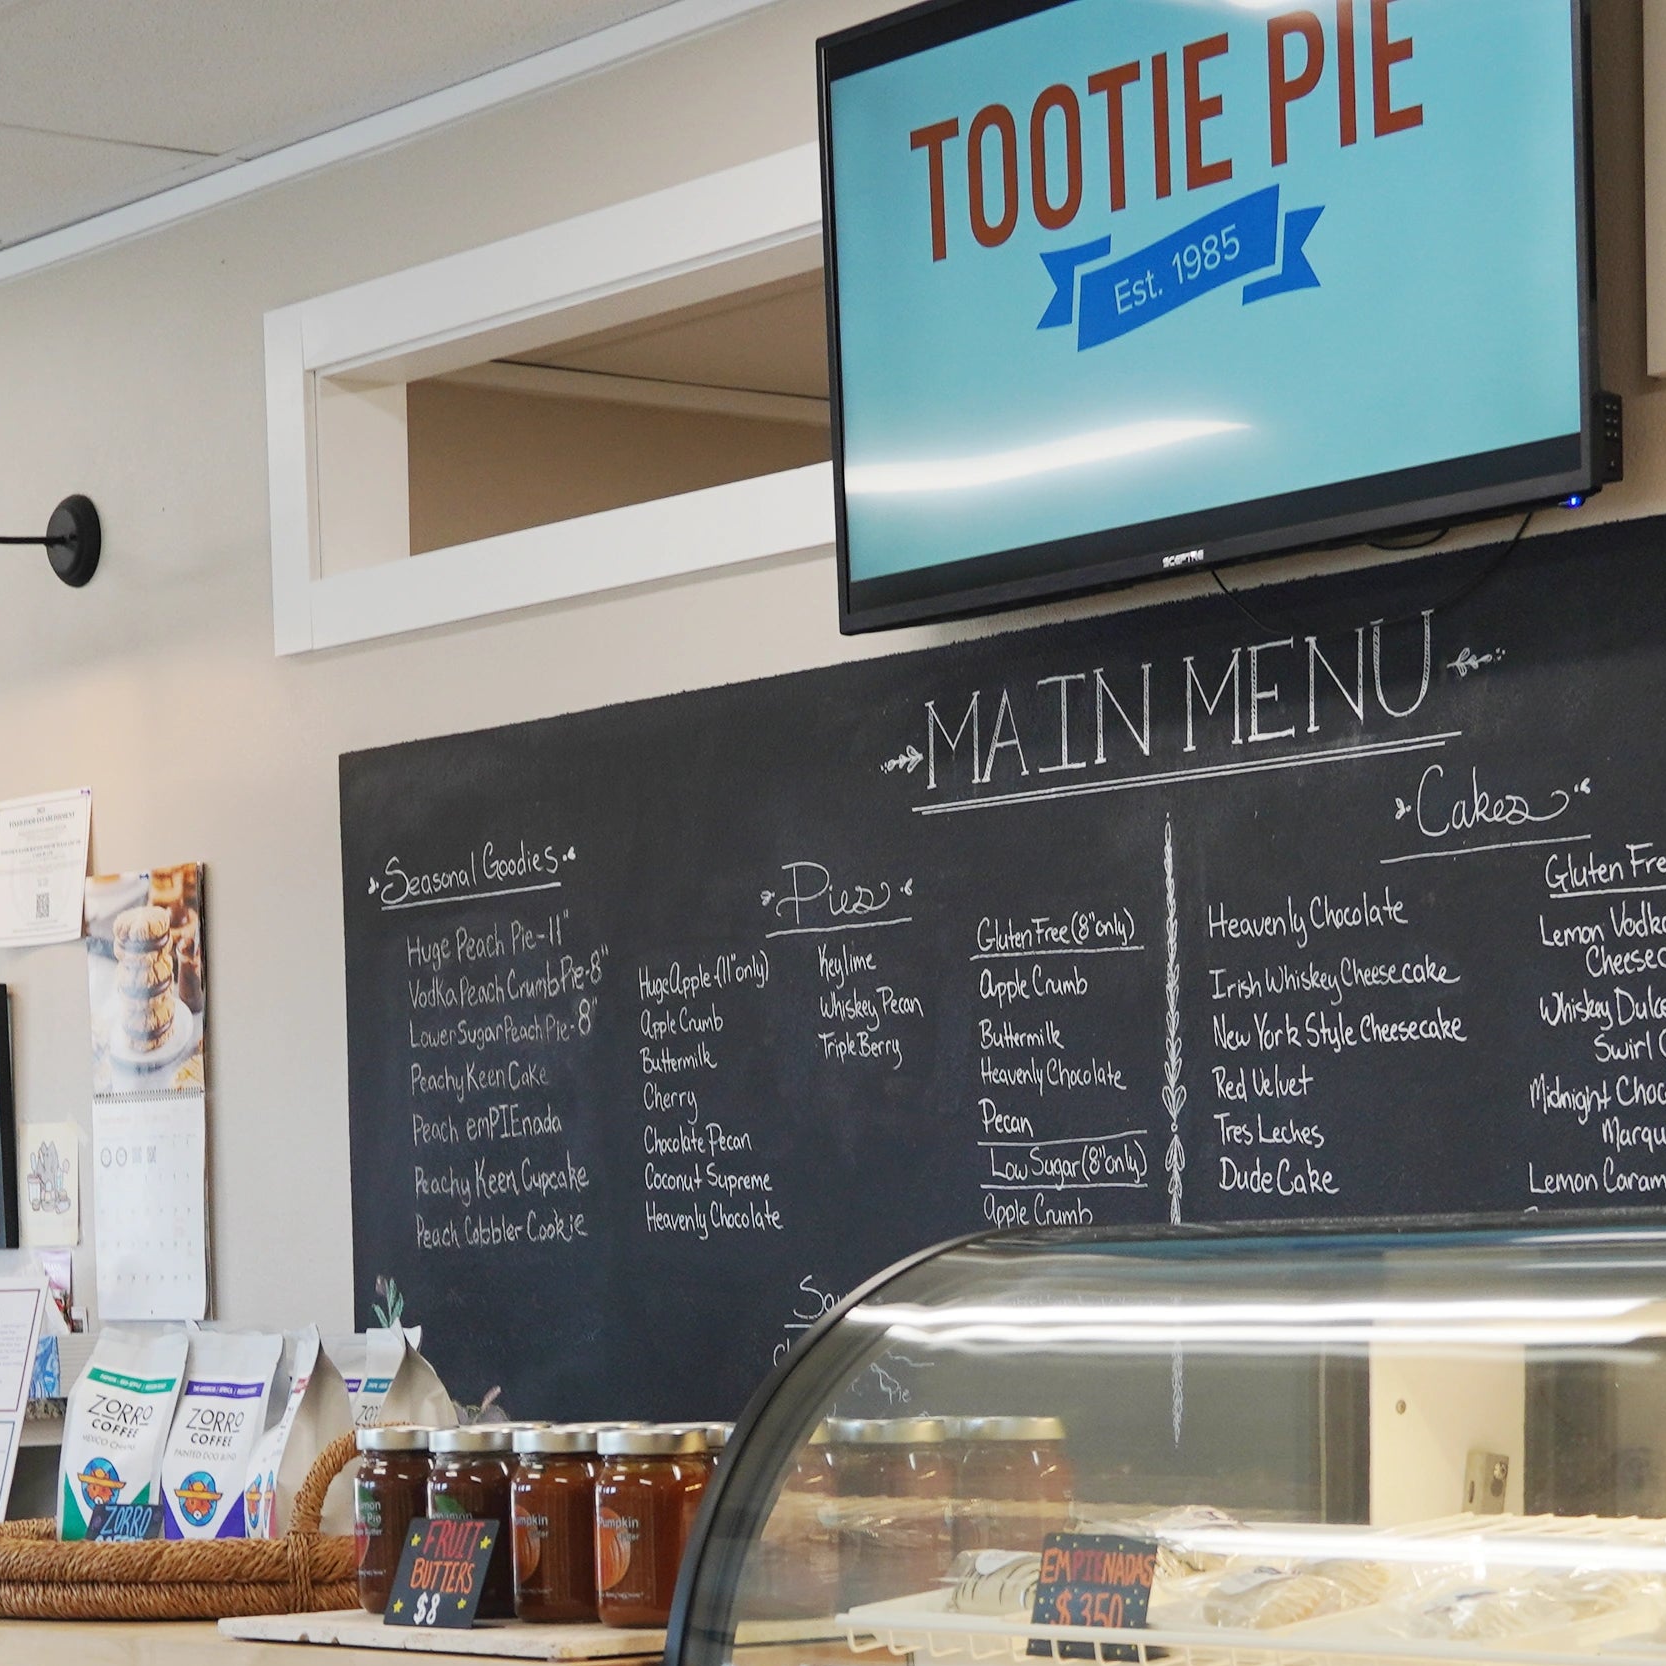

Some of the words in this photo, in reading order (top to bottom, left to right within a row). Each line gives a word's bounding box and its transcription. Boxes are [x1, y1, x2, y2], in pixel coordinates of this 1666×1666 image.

[909, 32, 1233, 263] TOOTIE
[1267, 0, 1424, 168] PIE
[1113, 269, 1163, 315] Est.
[1172, 224, 1241, 286] 1985
[925, 662, 1153, 790] MAIN
[1182, 609, 1434, 752] MENU
[1415, 765, 1569, 837] Cakes
[381, 856, 478, 905] Seasonal
[483, 840, 559, 880] Goodies
[1545, 851, 1624, 892] Gluten
[775, 861, 890, 924] Pies
[977, 919, 1032, 952] Gluten
[1031, 918, 1070, 943] Free
[1209, 896, 1307, 948] Heavenly
[1310, 886, 1409, 928] Chocolate
[1539, 914, 1604, 948] Lemon
[407, 935, 450, 970] Huge
[456, 924, 505, 960] Peach
[408, 978, 459, 1009] Vodka
[459, 976, 505, 1007] Peach
[508, 967, 560, 1000] Crumb
[639, 966, 671, 1001] Huge
[1032, 966, 1088, 996] Crumb
[1209, 968, 1262, 1000] Irish
[1265, 960, 1342, 1006] Whiskey
[1340, 954, 1461, 988] Cheesecake
[679, 1004, 724, 1032] Crumb
[820, 991, 879, 1031] Whiskey
[876, 987, 923, 1017] Pecan
[410, 1020, 459, 1049] Lower
[458, 1017, 504, 1051] Sugar
[504, 1014, 544, 1044] Peach
[980, 1019, 1064, 1050] Buttermilk
[1213, 1014, 1250, 1051] New
[1254, 1012, 1302, 1051] York
[1305, 1015, 1357, 1053] Style
[1359, 1006, 1468, 1043] Cheesecake
[1594, 1030, 1653, 1063] Swirl
[640, 1042, 717, 1073] Buttermilk
[817, 1033, 856, 1058] Triple
[857, 1034, 903, 1070] Berry
[410, 1062, 465, 1103] Peachy
[466, 1060, 506, 1091] Keen
[981, 1061, 1043, 1097] Heavenly
[1046, 1059, 1127, 1091] Chocolate
[1212, 1065, 1248, 1102] Red
[1253, 1064, 1314, 1098] Velvet
[644, 1084, 698, 1124] Cherry
[1529, 1072, 1612, 1126] Midnight
[412, 1112, 459, 1146] Peach
[978, 1099, 1033, 1138] Pecan
[1214, 1113, 1253, 1146] Tres
[1258, 1118, 1325, 1149] Leches
[644, 1125, 705, 1156] Chocolate
[707, 1123, 752, 1156] Pecan
[414, 1165, 471, 1206] Peachy
[474, 1157, 517, 1195] Keen
[521, 1152, 589, 1194] Cupcake
[644, 1162, 702, 1192] Coconut
[707, 1162, 773, 1192] Supreme
[990, 1148, 1028, 1180] Low
[1029, 1147, 1080, 1191] Sugar
[1219, 1156, 1272, 1193] Dude
[1276, 1158, 1340, 1196] Cake
[1528, 1161, 1598, 1194] Lemon
[416, 1214, 460, 1248] Peach
[464, 1212, 523, 1246] Cobbler
[527, 1208, 588, 1242] Cookie
[646, 1202, 709, 1240] Heavenly
[710, 1201, 783, 1232] Chocolate
[1034, 1200, 1092, 1226] Crumb
[88, 1394, 153, 1425] ZORRO
[92, 1419, 139, 1438] COFFEE
[186, 1407, 244, 1433] ZORRO
[191, 1433, 233, 1446] COFFEE
[100, 1506, 153, 1538] ZORRO
[423, 1519, 485, 1560] FRUIT
[598, 1516, 639, 1528] Pumpkin
[410, 1557, 476, 1595] BUTTERS
[1040, 1546, 1157, 1588] EMPIENADAS
[413, 1591, 441, 1626] $8
